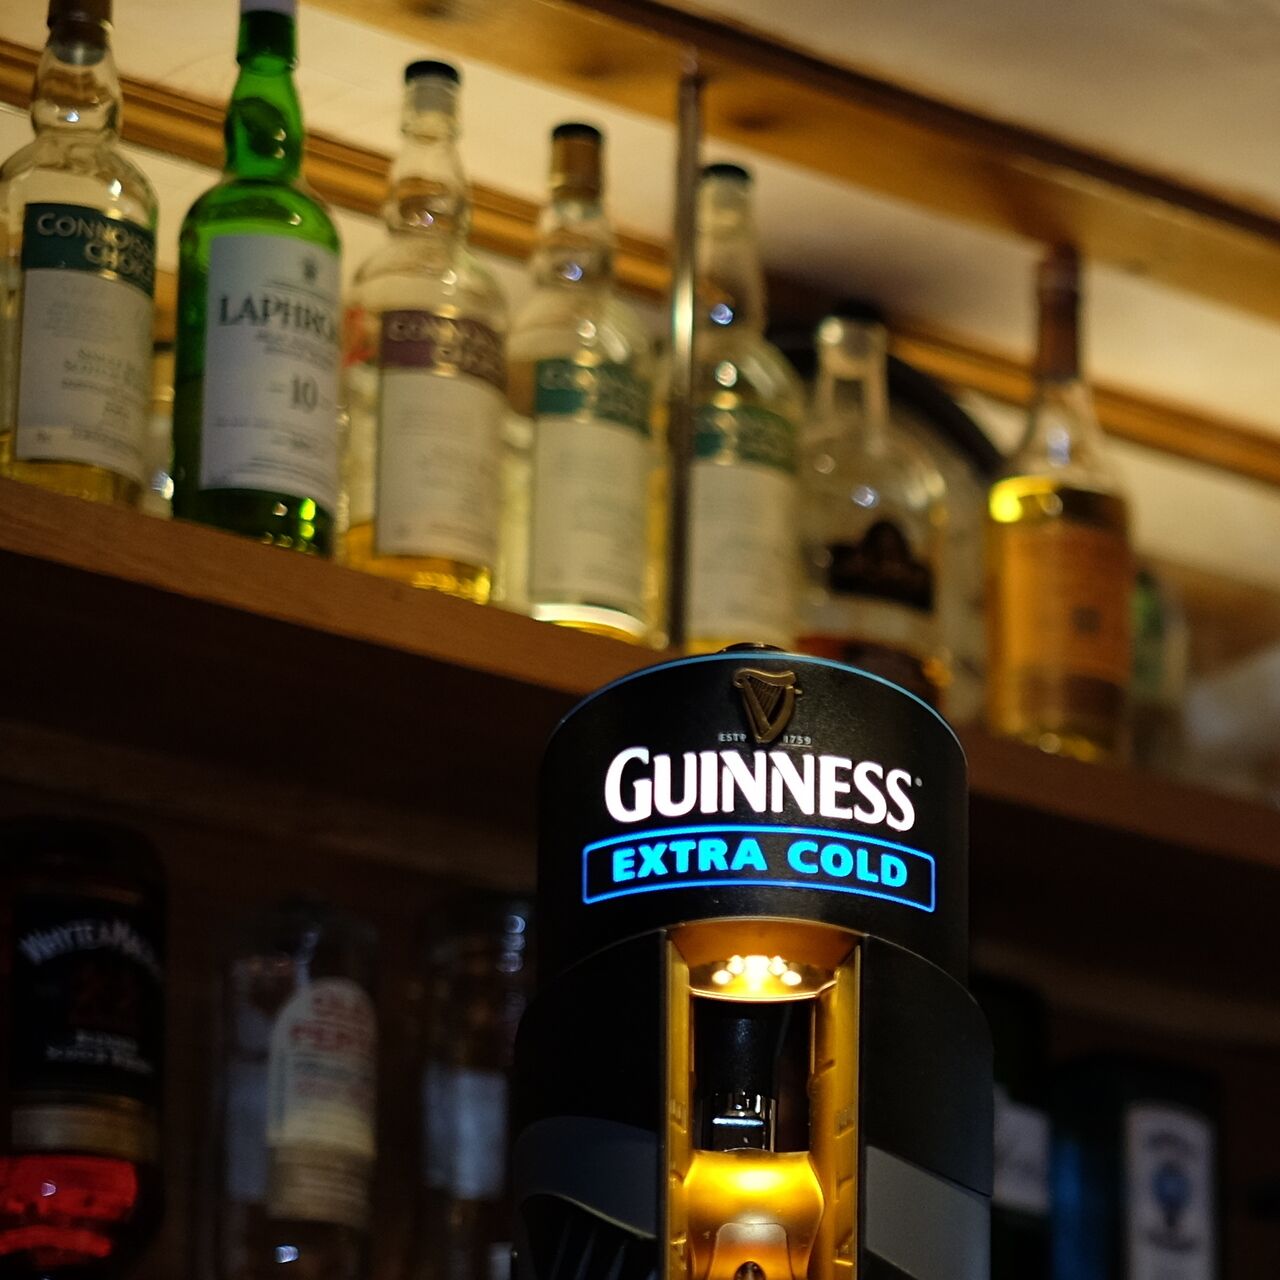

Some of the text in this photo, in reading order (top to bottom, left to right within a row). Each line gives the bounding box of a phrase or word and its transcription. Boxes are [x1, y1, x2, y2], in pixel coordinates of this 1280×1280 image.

[782, 734, 812, 746] 1759
[604, 746, 916, 832] GUINNESS
[612, 837, 908, 888] EXTRA COLD
